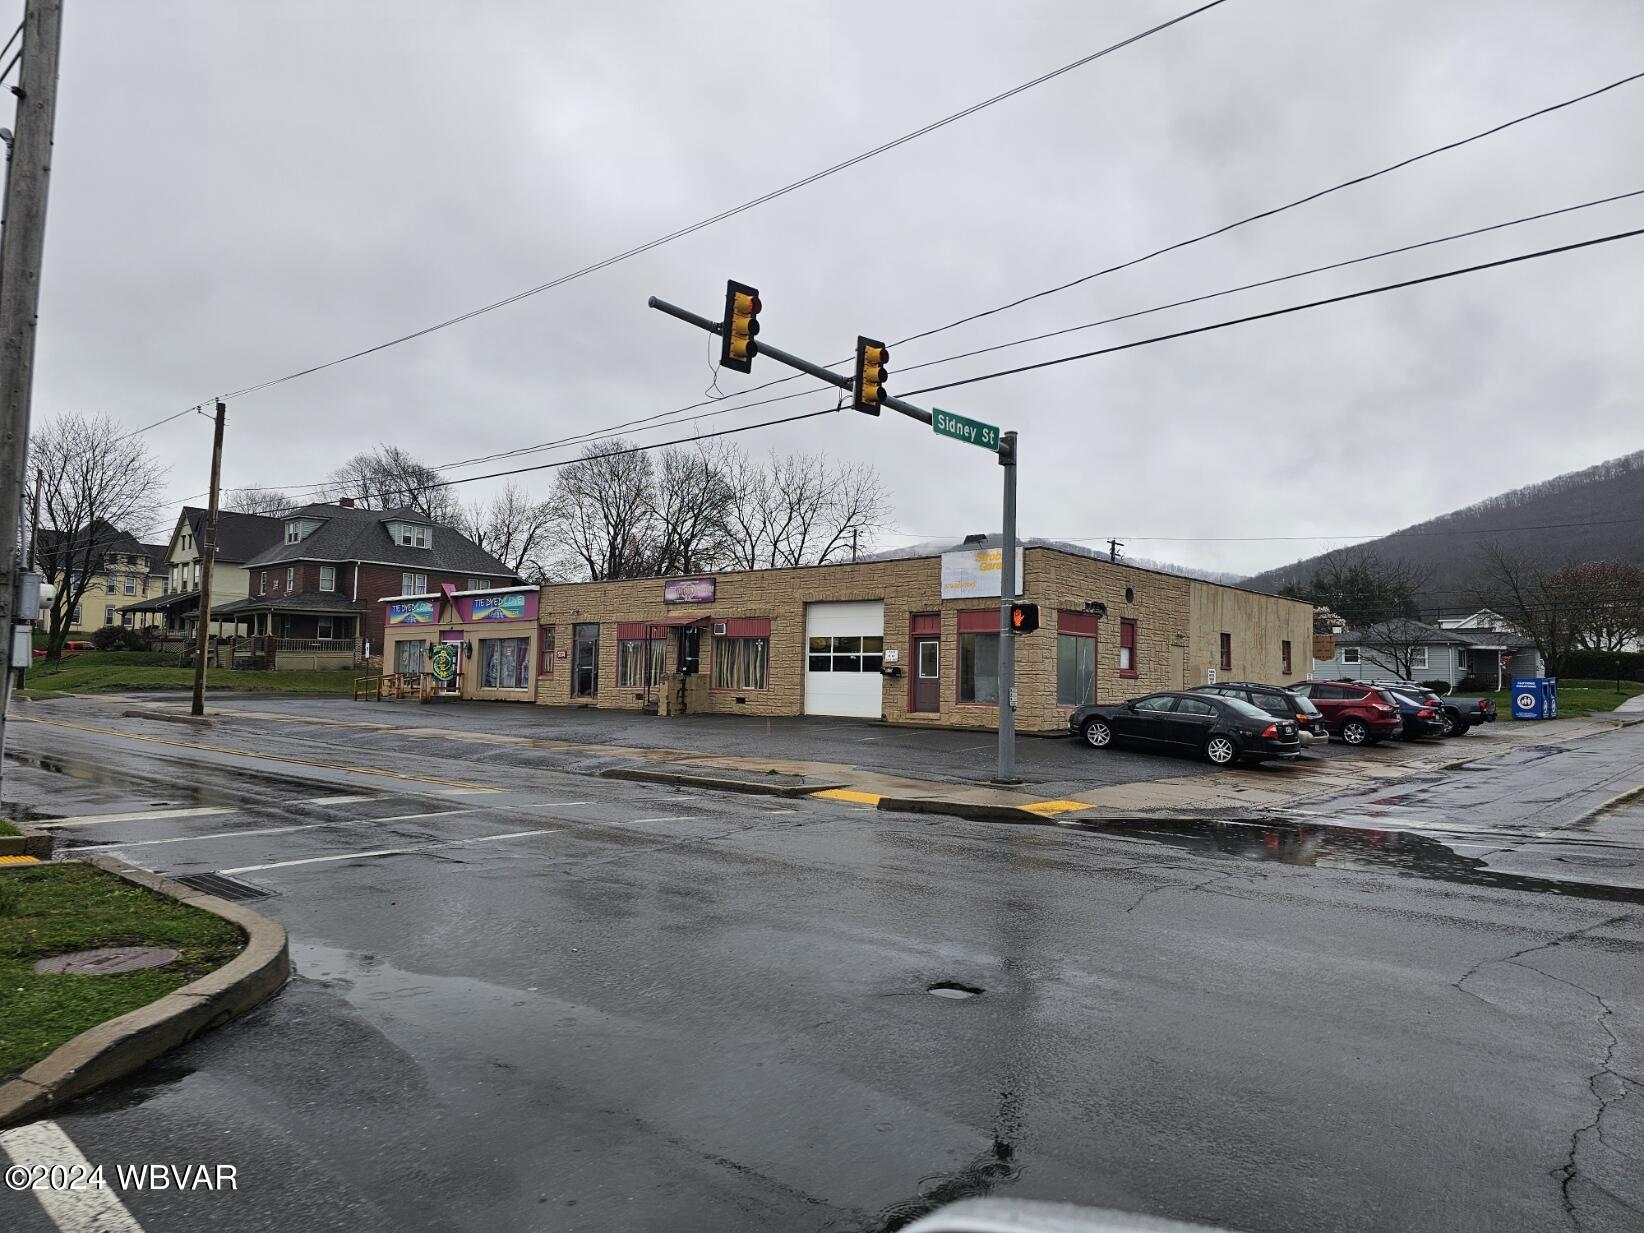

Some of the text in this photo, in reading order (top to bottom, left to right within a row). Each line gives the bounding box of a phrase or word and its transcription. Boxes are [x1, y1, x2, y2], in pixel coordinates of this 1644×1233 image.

[938, 414, 995, 445] Sidney St
[474, 599, 484, 607] TIE
[486, 597, 502, 608] DYED
[402, 603, 415, 614] DYED
